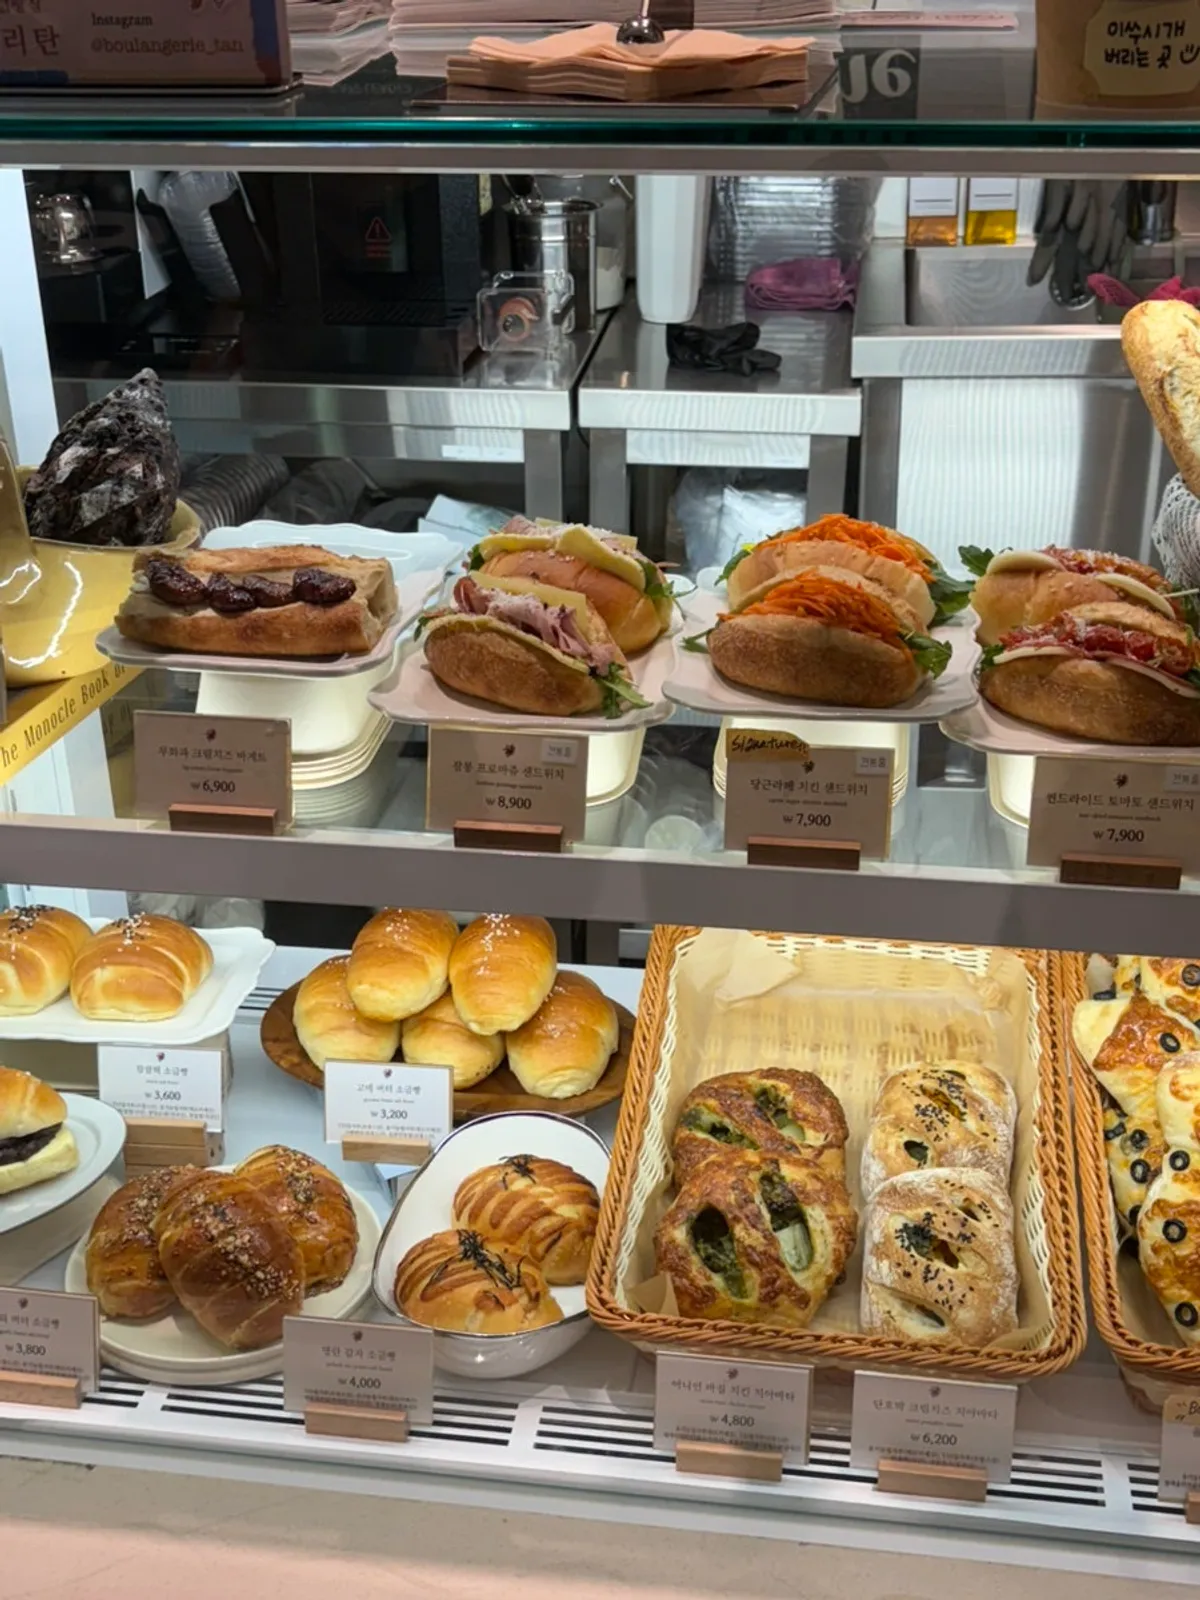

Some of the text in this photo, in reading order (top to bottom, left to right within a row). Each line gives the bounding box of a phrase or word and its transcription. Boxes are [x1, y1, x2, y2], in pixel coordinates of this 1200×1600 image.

[91, 13, 153, 28] Instagram
[1106, 20, 1186, 45] 이쑤시개
[91, 37, 244, 55] @boulangerie_tan
[1104, 44, 1172, 69] 버리는 곳
[24, 697, 77, 750] Monocle
[80, 668, 110, 705] Book
[202, 779, 236, 793] 6,900
[825, 782, 869, 797] 샌드위치
[497, 795, 533, 810] 8,900
[1107, 795, 1144, 809] 토마토
[1147, 796, 1196, 812] 샌드위치
[796, 813, 831, 827] 7,900
[1106, 828, 1145, 843] 7,900
[154, 1090, 182, 1101] 3,600
[380, 1108, 408, 1120] 3,200
[15, 1342, 47, 1356] 3,800
[349, 1376, 382, 1389] 4,000
[721, 1413, 756, 1428] 4,800
[922, 1431, 958, 1446] 6,200
